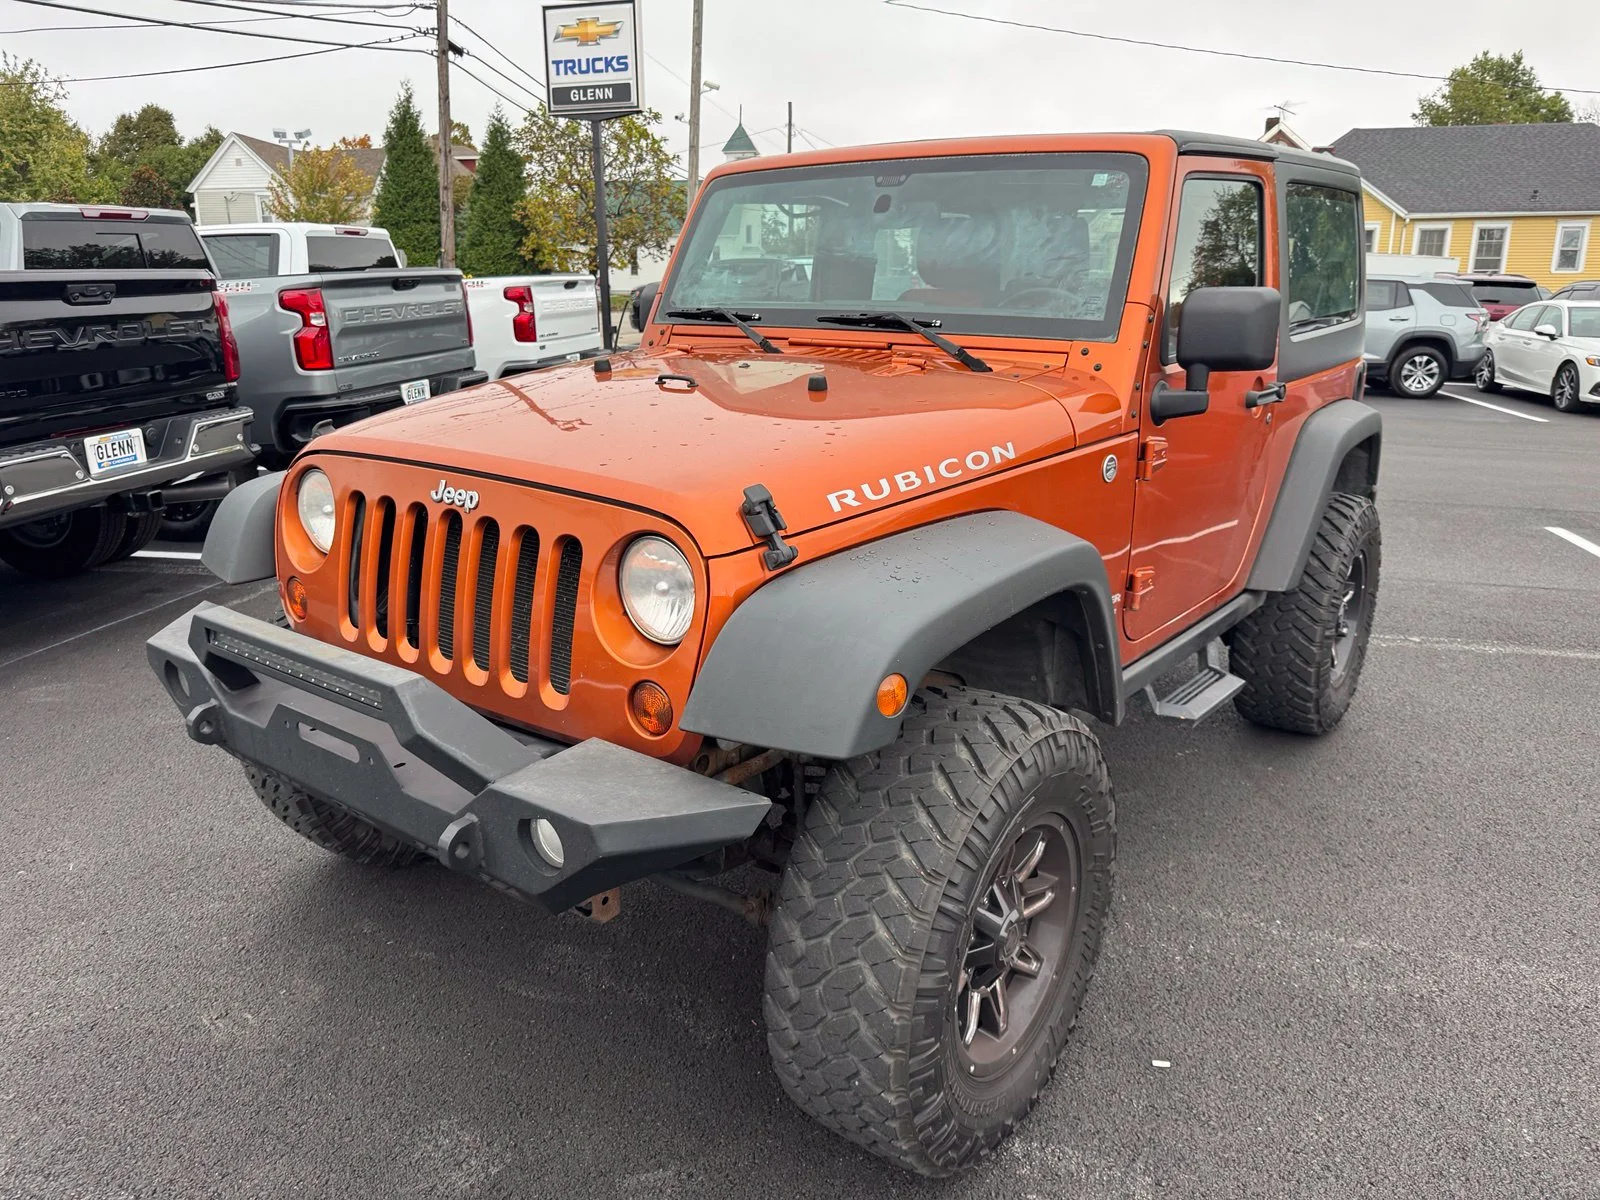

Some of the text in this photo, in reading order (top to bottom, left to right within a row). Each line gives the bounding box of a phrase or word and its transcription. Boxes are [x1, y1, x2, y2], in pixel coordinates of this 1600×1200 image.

[551, 55, 629, 76] TRUCKS
[570, 87, 613, 101] GLENN
[343, 301, 463, 325] CHEVROLET
[0, 319, 206, 350] HEVROLET
[407, 387, 426, 401] GLENN
[96, 438, 134, 460] GLENN
[826, 441, 1016, 513] RUBICON
[430, 479, 479, 514] Jeep
